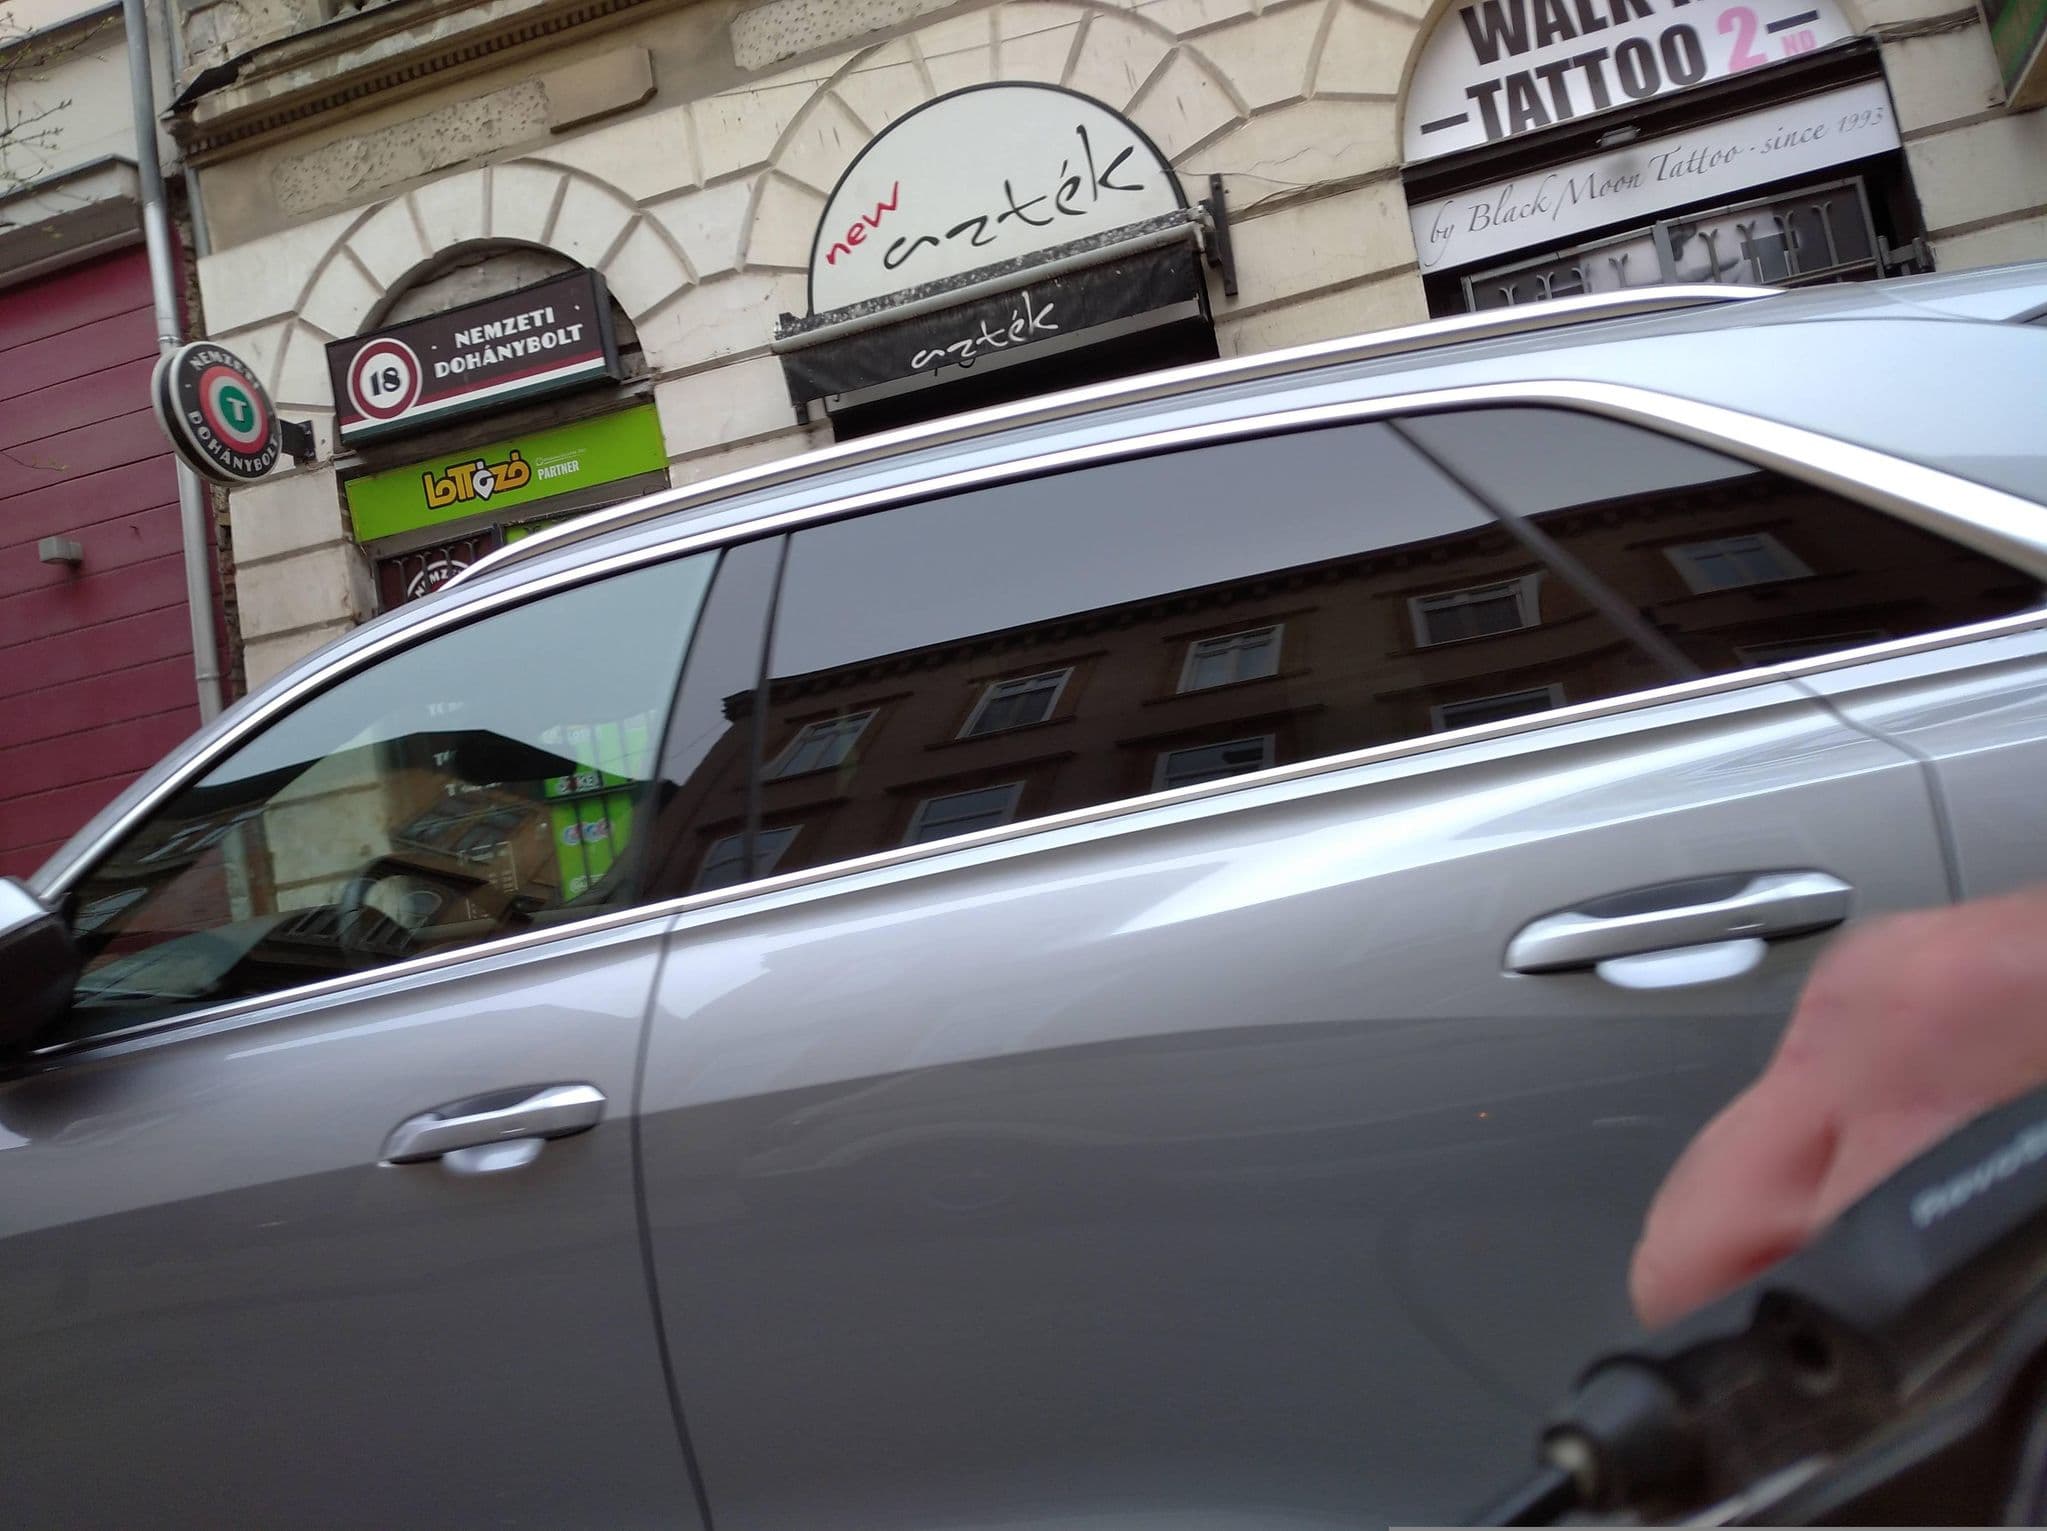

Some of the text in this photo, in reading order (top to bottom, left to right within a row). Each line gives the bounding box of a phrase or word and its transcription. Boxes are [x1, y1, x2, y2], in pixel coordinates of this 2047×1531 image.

[1466, 22, 1707, 142] TATTOO
[884, 124, 1144, 270] azték
[1423, 200, 1455, 267] by
[1468, 174, 1557, 233] Black
[1552, 171, 1641, 222] Moon
[1649, 146, 1742, 182] Tattoo
[1760, 126, 1828, 155] since
[1838, 107, 1885, 134] 1993
[825, 181, 899, 266] new
[435, 323, 583, 378] DOHÁNYBOLT
[455, 307, 555, 348] NEMZETI
[911, 292, 1058, 369] azték
[226, 397, 247, 422] T
[369, 366, 402, 396] 18
[188, 410, 278, 472] DOHÁNYBOLT
[537, 460, 580, 481] PARTNER
